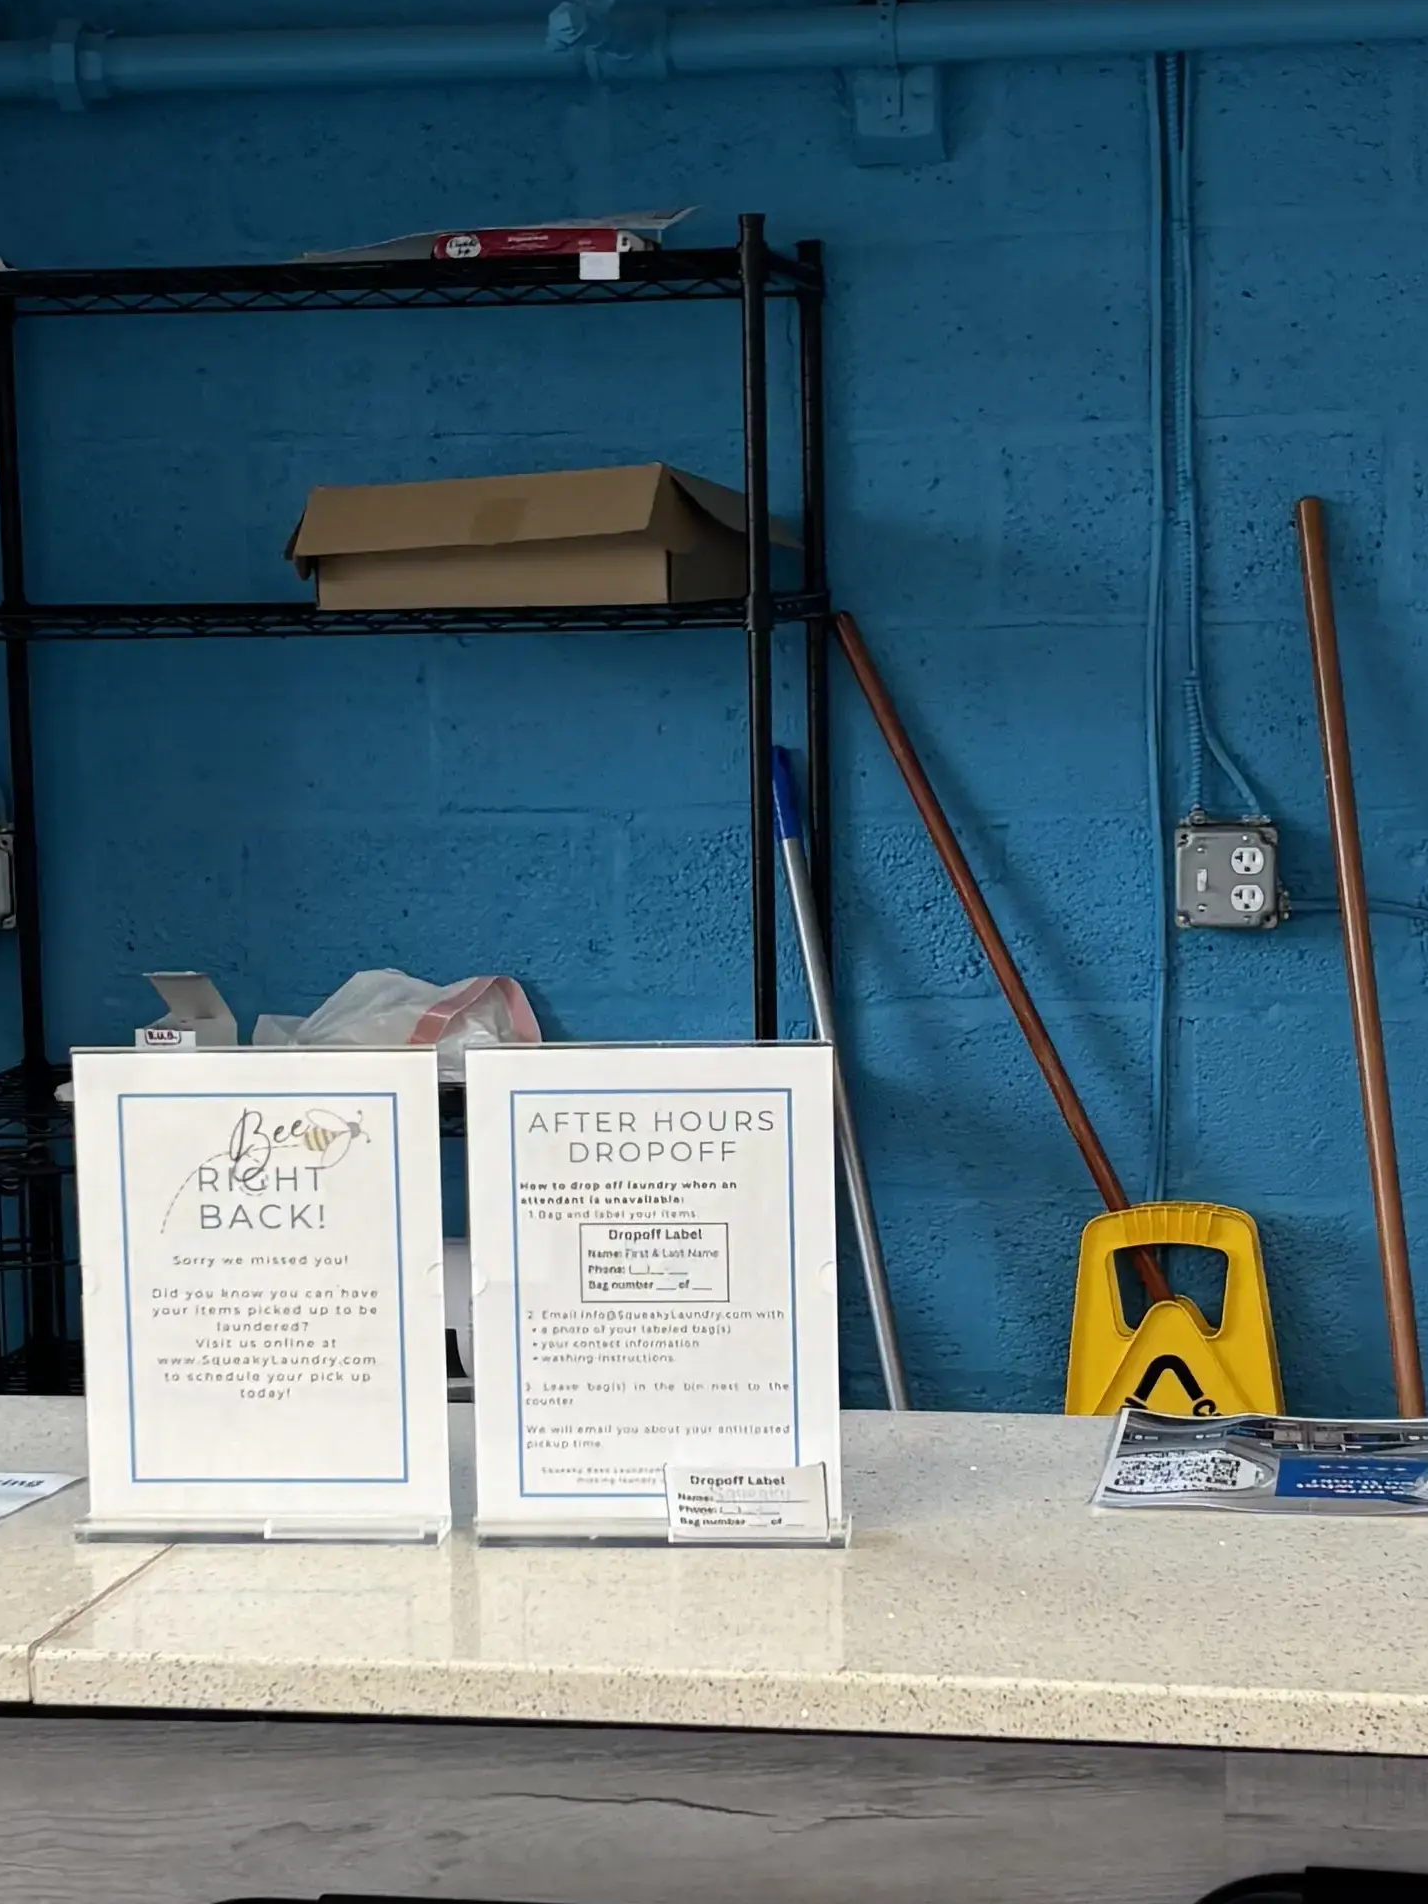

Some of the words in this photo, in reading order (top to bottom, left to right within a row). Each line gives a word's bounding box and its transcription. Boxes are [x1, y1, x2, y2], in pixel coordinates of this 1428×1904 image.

[528, 1111, 637, 1133] AFTER
[654, 1110, 775, 1132] HOURS
[228, 1107, 309, 1182] Bee
[569, 1141, 737, 1164] DROPOFF
[198, 1166, 325, 1193] RIGHT
[552, 1181, 566, 1191] to
[570, 1181, 600, 1193] drop
[605, 1180, 624, 1191] off
[627, 1180, 677, 1193] laundry
[681, 1180, 717, 1190] when
[722, 1180, 738, 1190] an
[200, 1204, 325, 1230] BACK!
[608, 1228, 661, 1244] Dropoff
[665, 1228, 702, 1241] Label
[172, 1255, 216, 1268] Sorry
[222, 1256, 244, 1265] we
[250, 1255, 308, 1265] missed
[314, 1255, 349, 1268] you!
[152, 1287, 179, 1299] Did
[185, 1289, 214, 1301] you
[221, 1287, 264, 1299] know
[270, 1289, 298, 1301] you
[305, 1289, 333, 1299] can
[340, 1287, 379, 1299] have
[152, 1305, 188, 1318] your
[195, 1304, 241, 1316] items
[247, 1304, 302, 1317] picked
[309, 1305, 329, 1317] up
[335, 1305, 352, 1315] to
[359, 1304, 378, 1315] be
[217, 1321, 310, 1332] laundered?
[195, 1337, 232, 1349] Visit
[239, 1339, 257, 1349] us
[263, 1337, 315, 1349] online
[322, 1338, 337, 1349] at
[164, 1371, 180, 1382] to
[187, 1371, 261, 1382] schedule
[267, 1372, 303, 1385] your
[310, 1371, 344, 1383] pick
[351, 1373, 371, 1383] up
[240, 1388, 292, 1401] today!
